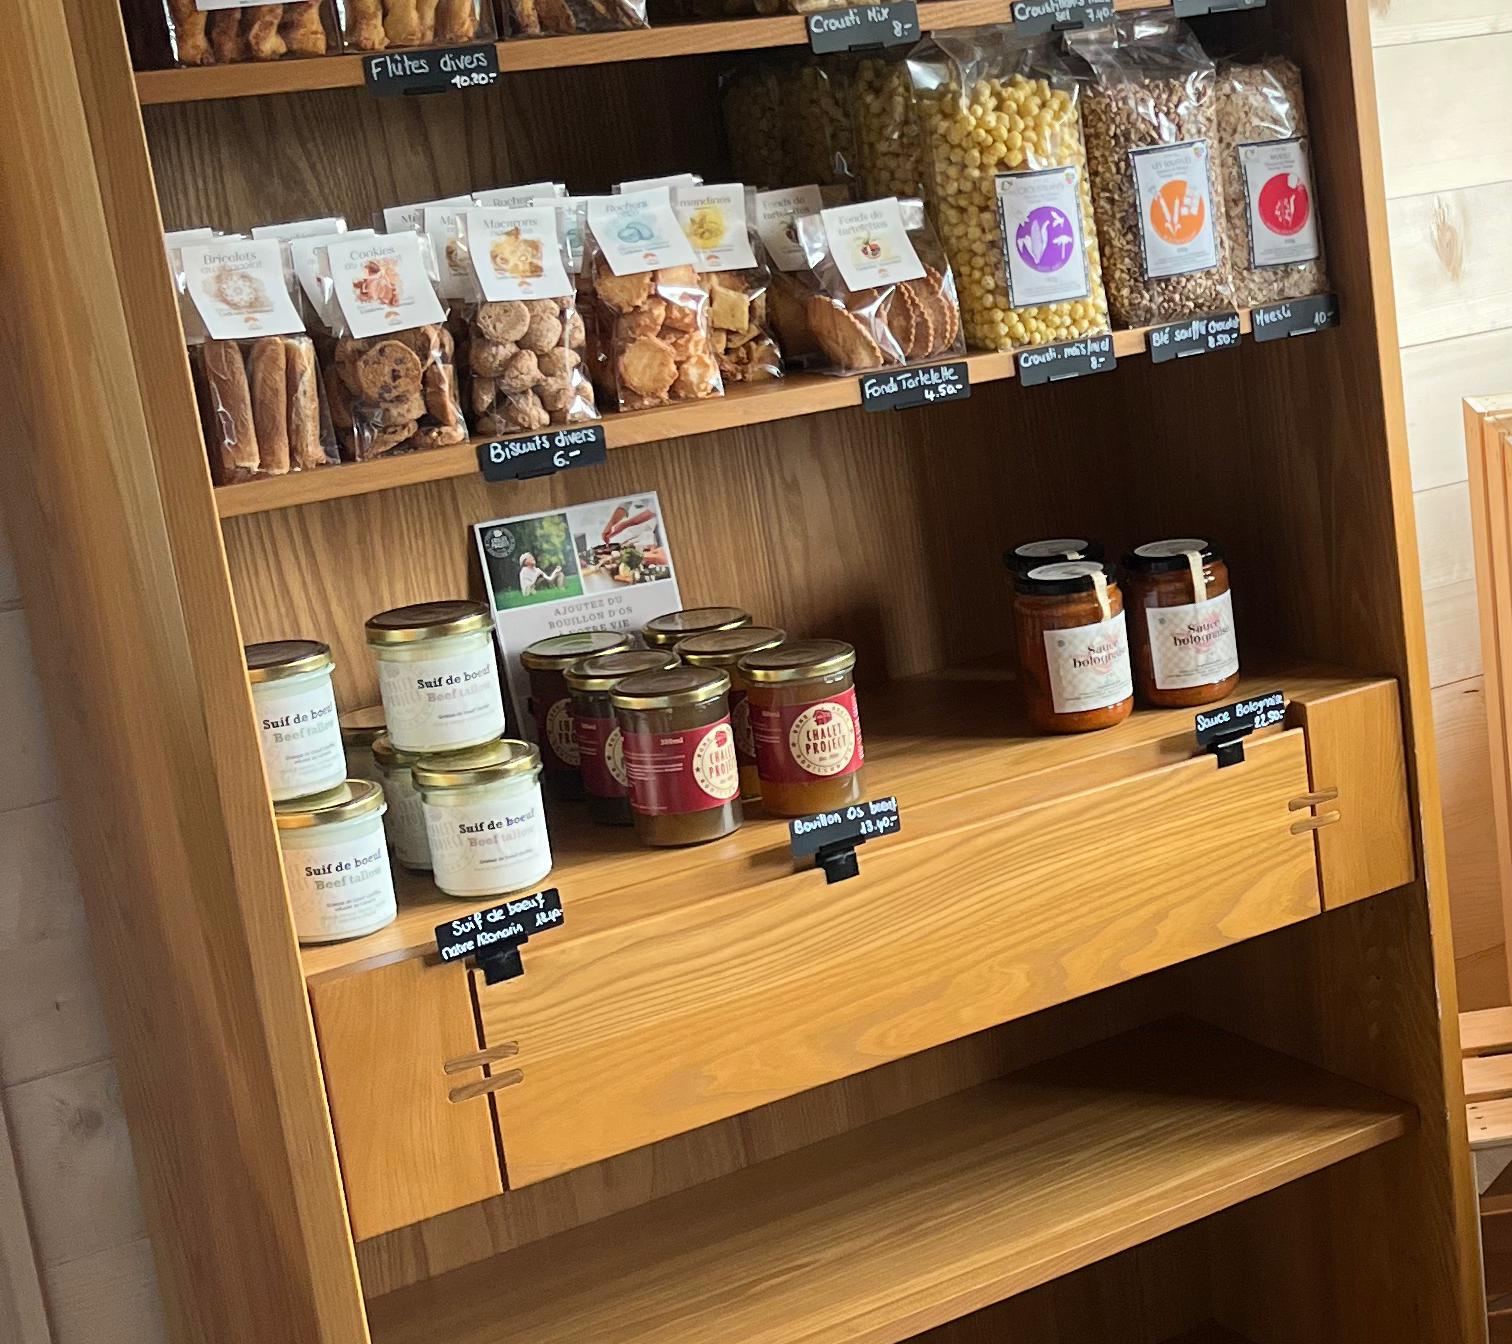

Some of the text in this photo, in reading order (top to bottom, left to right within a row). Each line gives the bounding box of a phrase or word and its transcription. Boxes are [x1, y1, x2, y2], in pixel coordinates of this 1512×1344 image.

[810, 8, 861, 33] Crousti
[370, 52, 488, 81] Flûtes divers
[349, 246, 396, 260] Cookies
[489, 428, 597, 464] Biscuits divers
[607, 595, 624, 607] DU
[547, 611, 606, 629] BOUILLON
[610, 618, 631, 632] VIE
[1186, 619, 1221, 635] Sauce
[417, 676, 443, 690] Suif
[445, 674, 462, 686] de
[427, 688, 457, 703] Beef
[262, 715, 290, 730] Suif
[293, 713, 309, 724] de
[1196, 711, 1231, 732] Sauce
[806, 722, 842, 743] CHALET
[805, 734, 848, 755] PROJECT
[458, 821, 485, 835] Suif
[487, 820, 504, 831] de
[794, 812, 842, 835] Bouillon
[468, 834, 499, 848] Beef
[304, 863, 333, 877] Suif
[335, 861, 352, 873] de
[314, 875, 348, 891] Beef
[451, 911, 483, 937] Suif
[486, 908, 506, 923] de
